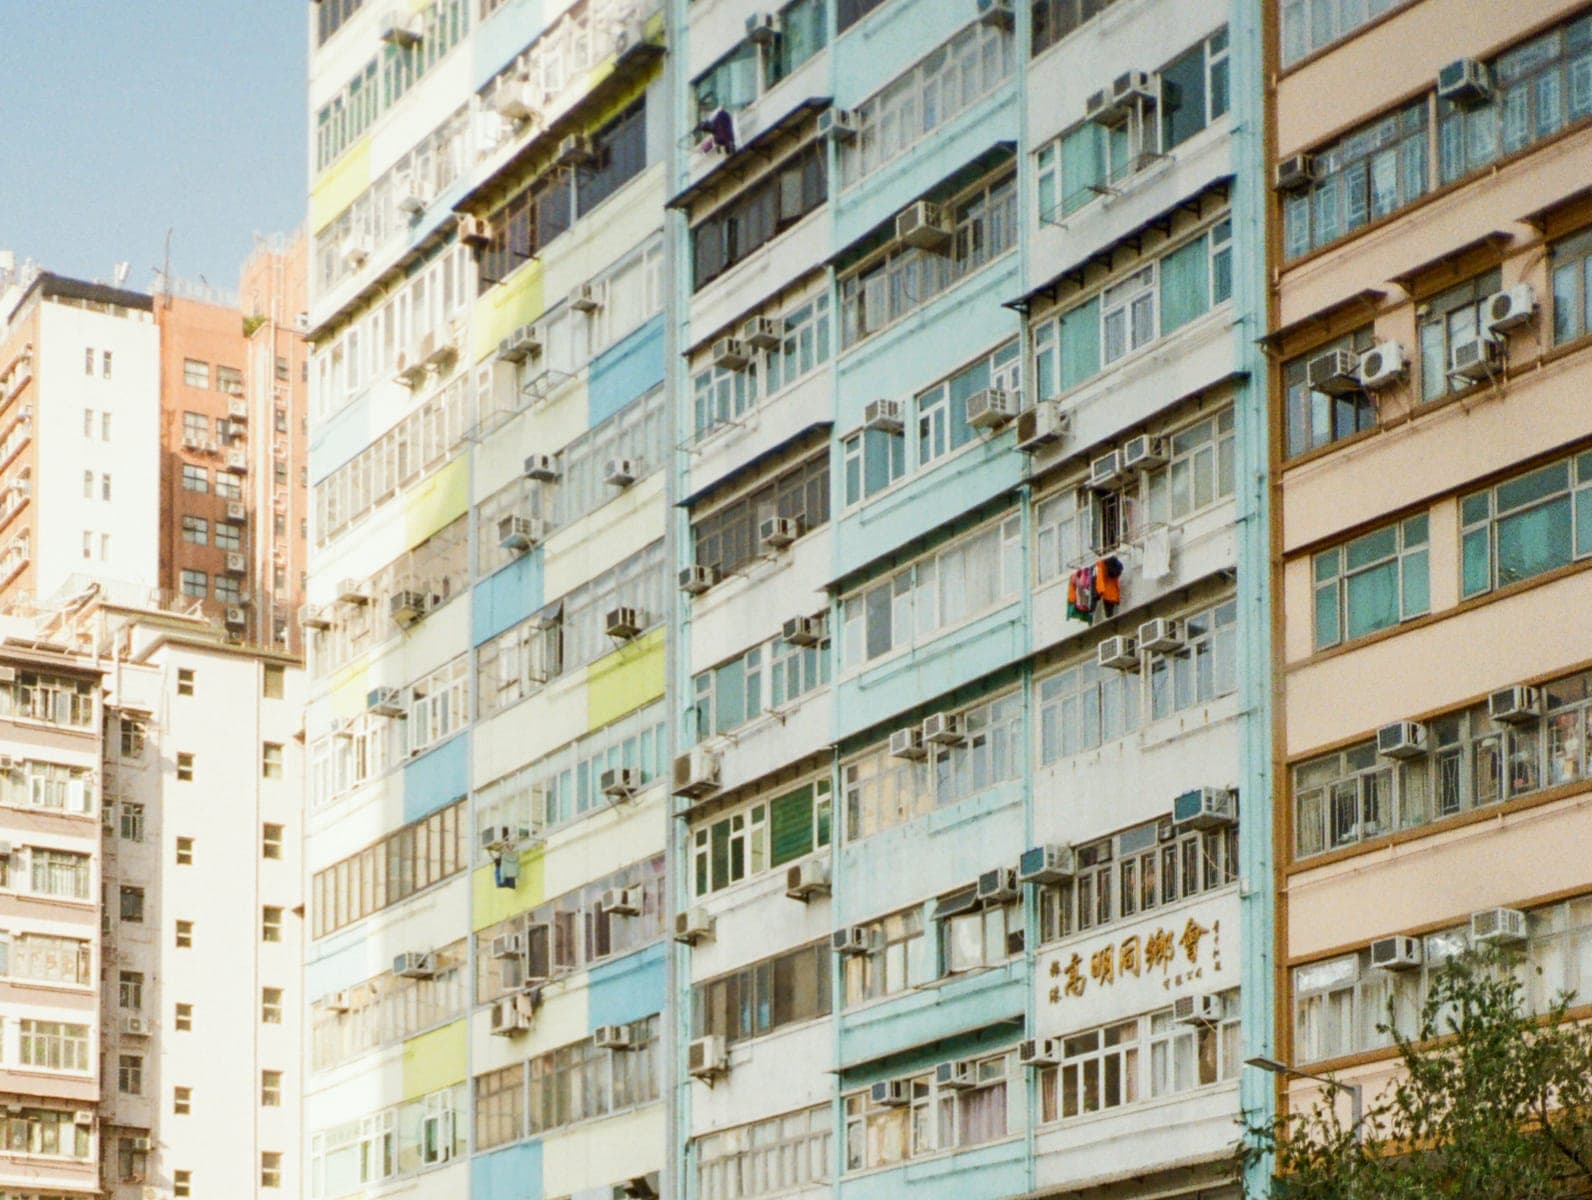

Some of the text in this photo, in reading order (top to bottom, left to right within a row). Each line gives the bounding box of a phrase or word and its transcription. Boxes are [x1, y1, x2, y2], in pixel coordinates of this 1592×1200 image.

[1063, 917, 1209, 998] 高明同鄉會
